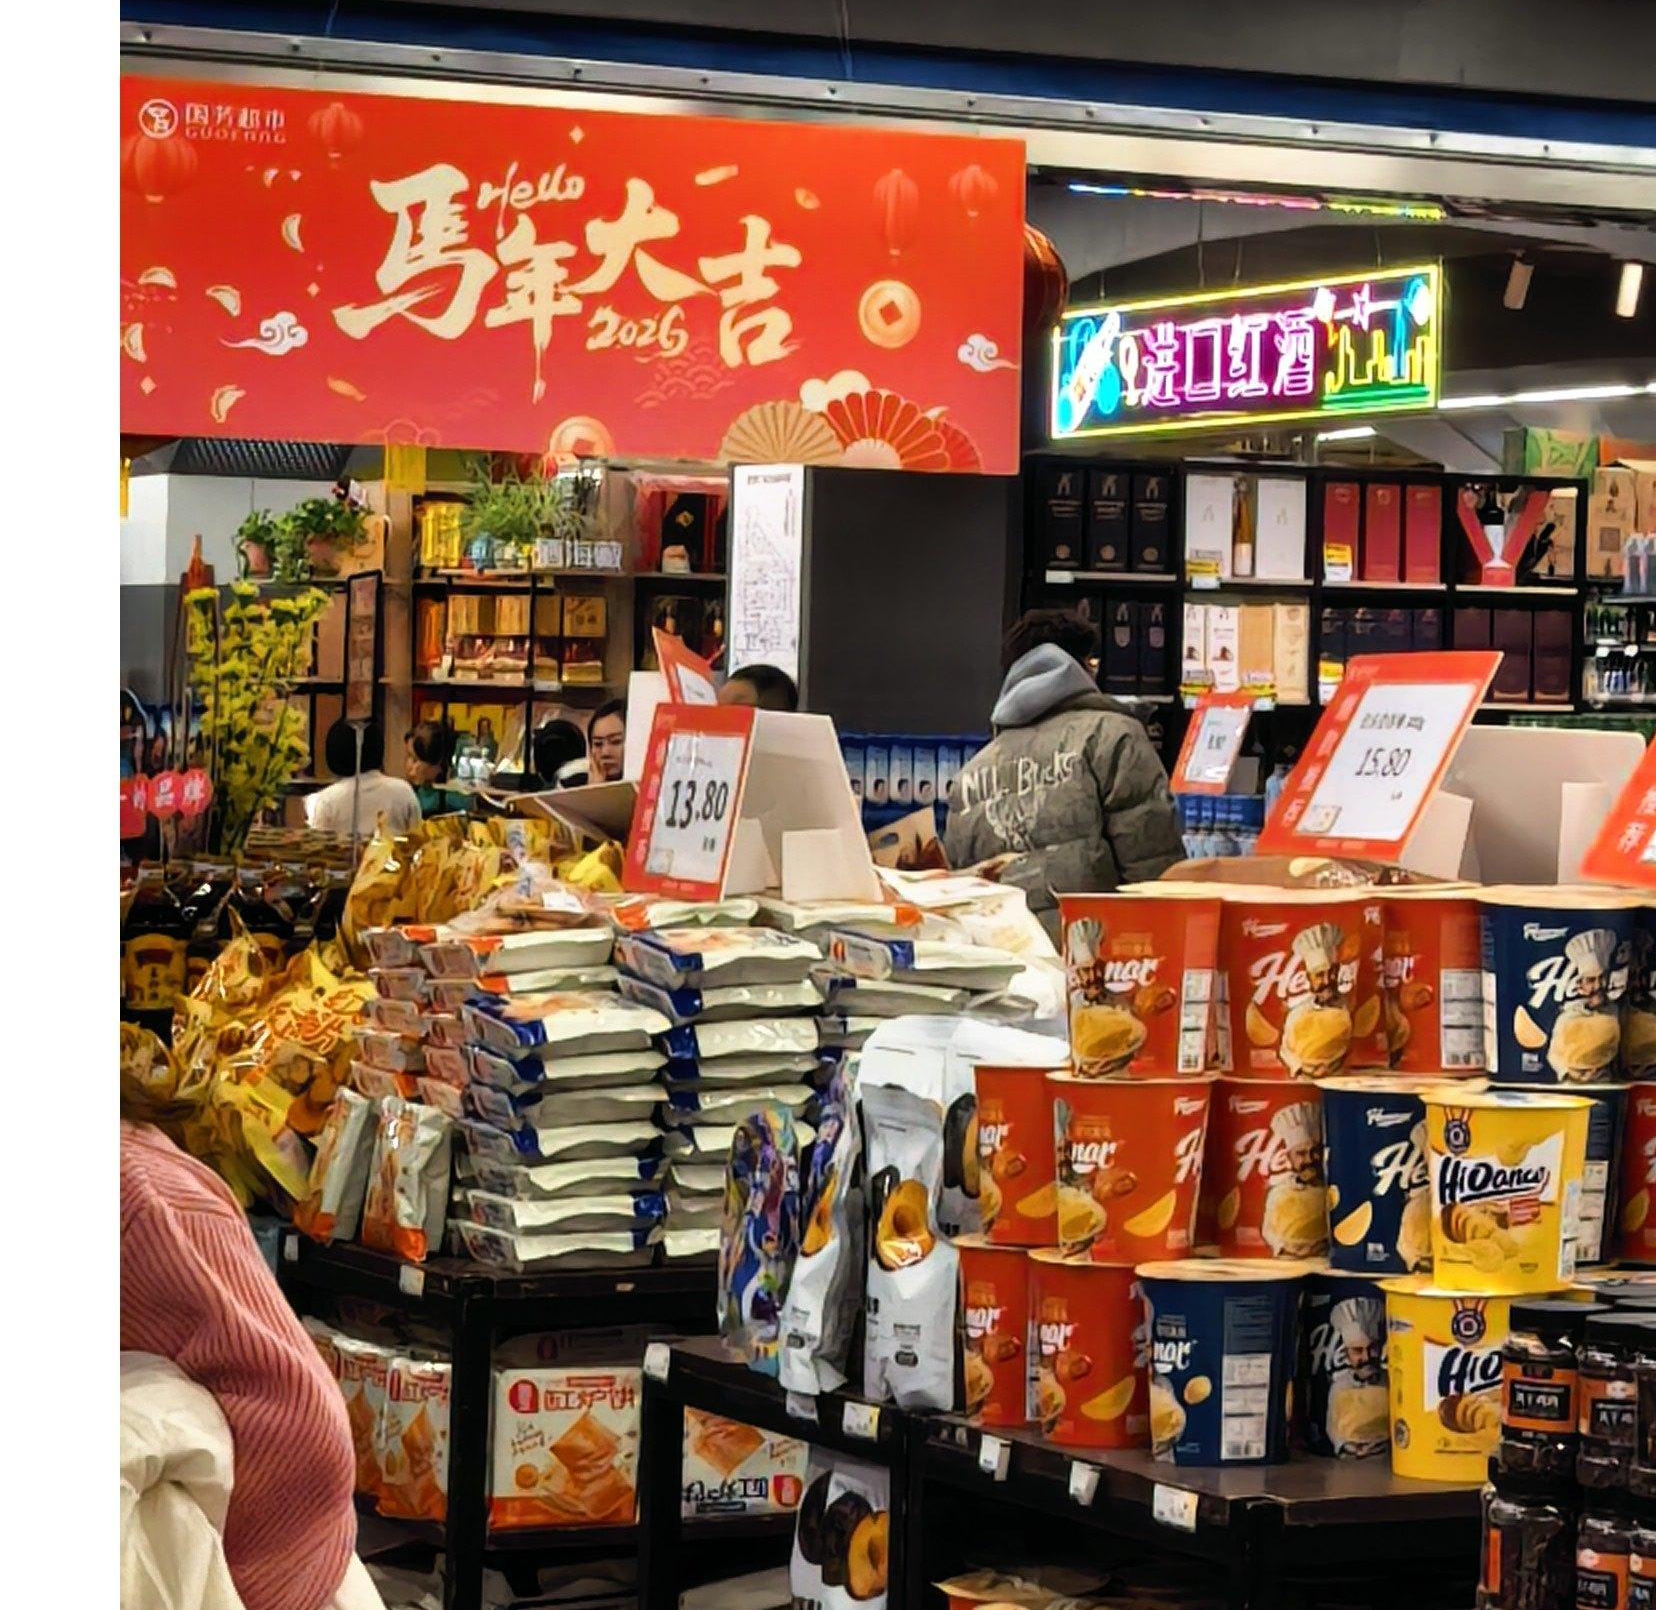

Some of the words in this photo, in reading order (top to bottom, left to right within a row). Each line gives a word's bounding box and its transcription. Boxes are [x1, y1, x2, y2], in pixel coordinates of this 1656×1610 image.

[477, 160, 586, 235] Hello
[586, 309, 688, 359] 2026
[1354, 747, 1412, 777] 15.80
[665, 780, 730, 830] 13.80
